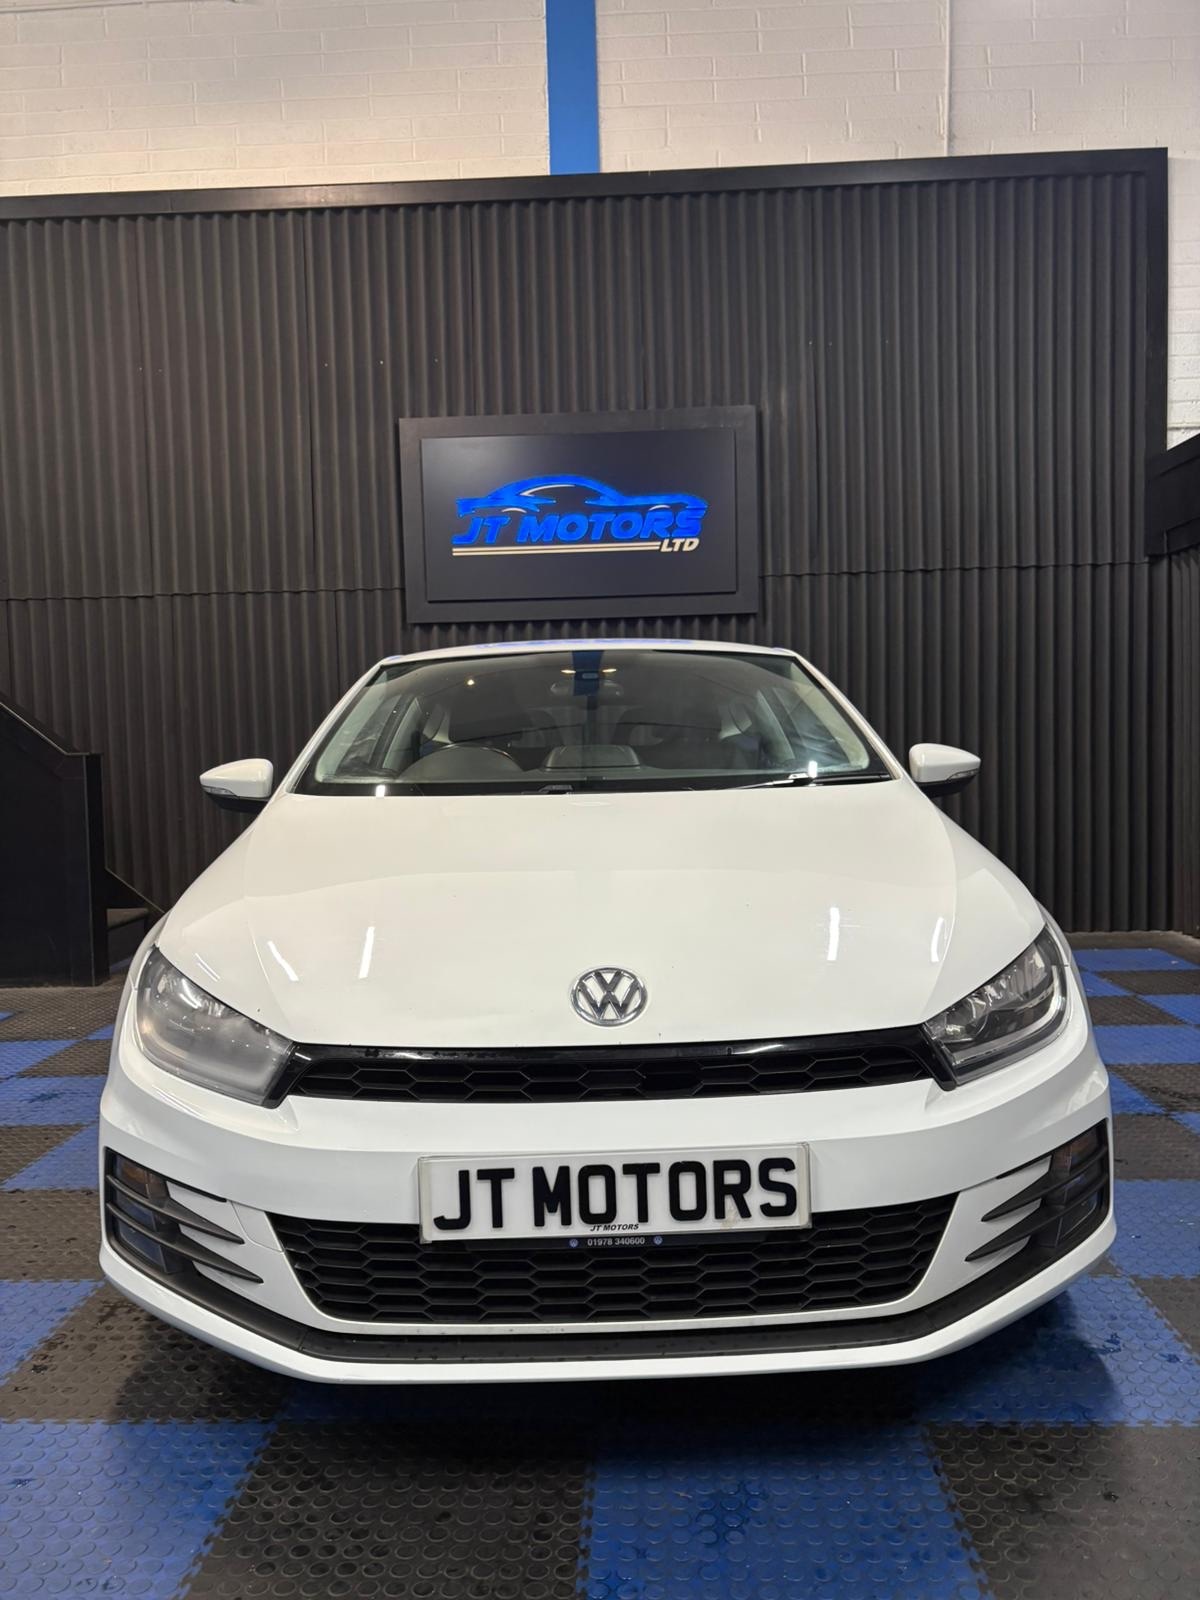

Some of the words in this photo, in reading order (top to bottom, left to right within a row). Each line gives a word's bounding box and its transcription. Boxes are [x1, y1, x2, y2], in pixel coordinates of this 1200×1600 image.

[451, 515, 511, 545] JT
[516, 511, 706, 543] MOTORS
[660, 537, 700, 552] LTD
[433, 1167, 515, 1231] JT
[532, 1157, 798, 1227] MOTORS
[590, 1224, 602, 1232] JT
[603, 1223, 639, 1231] MOTORS
[587, 1238, 613, 1246] 01978
[614, 1237, 645, 1246] 340600
